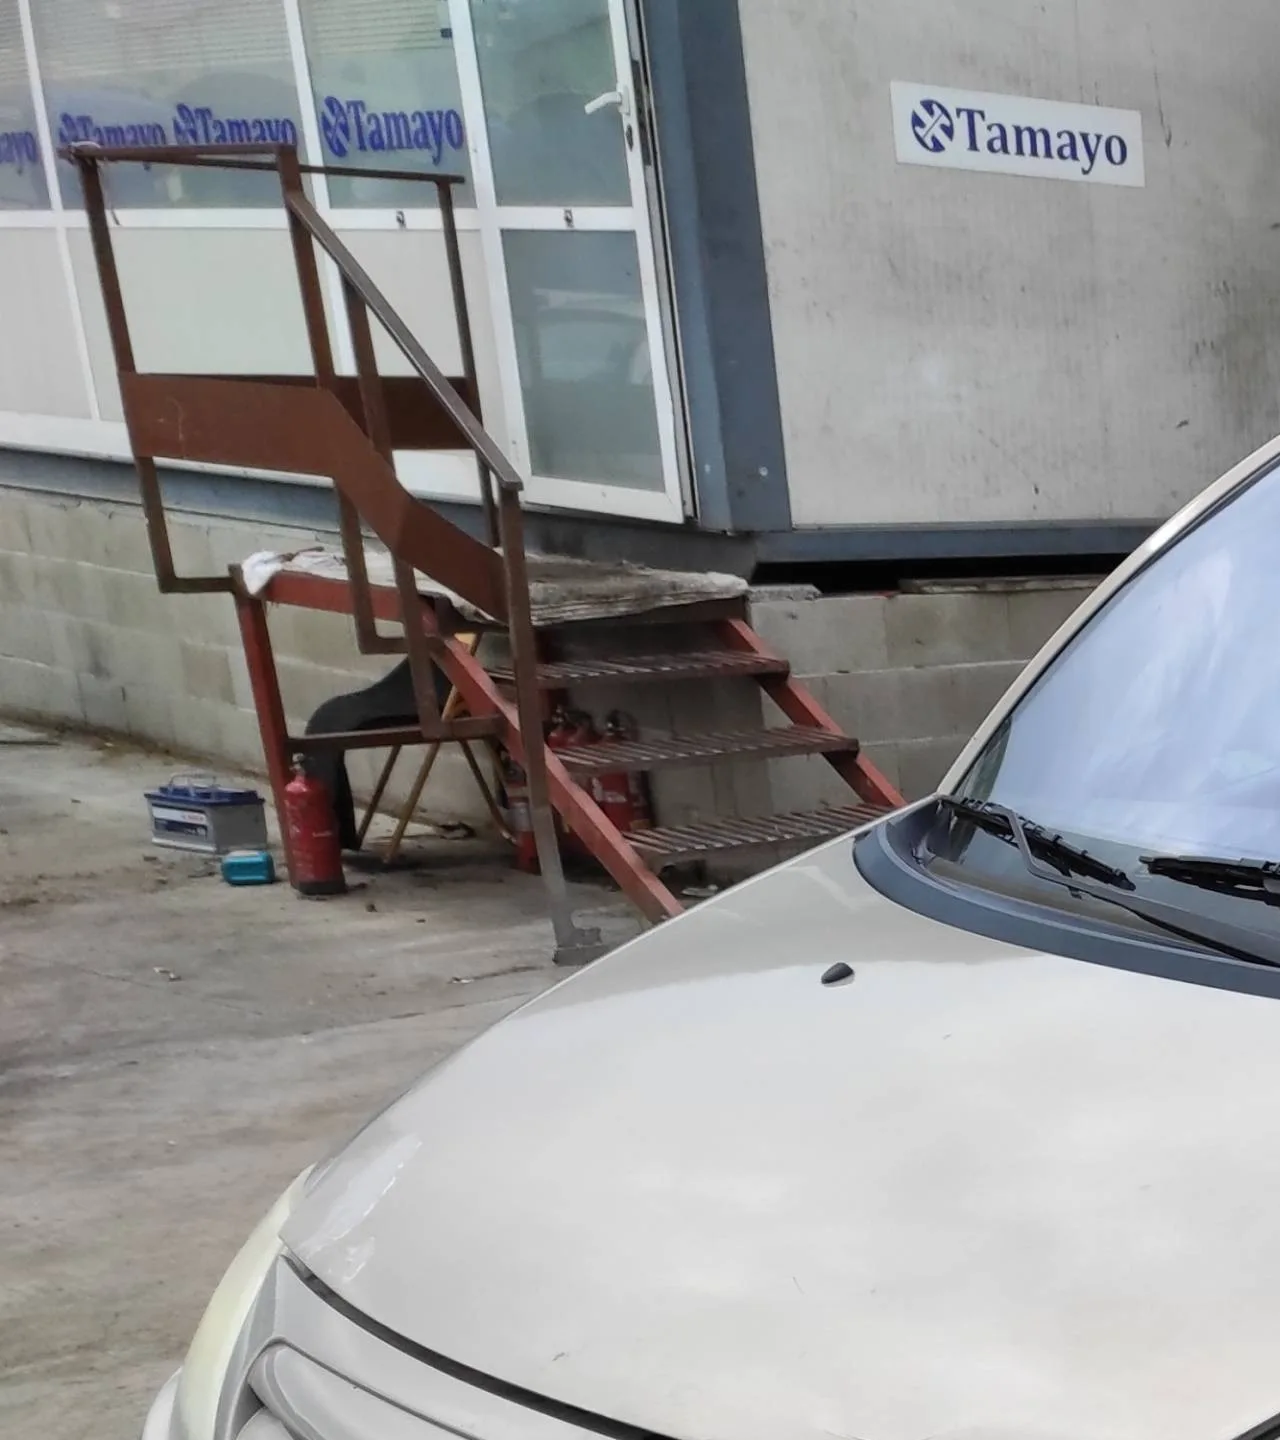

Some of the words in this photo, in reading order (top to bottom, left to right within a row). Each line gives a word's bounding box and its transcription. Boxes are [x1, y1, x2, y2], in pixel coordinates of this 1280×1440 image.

[0, 131, 37, 177] ayo
[347, 99, 464, 166] Tamayo
[955, 107, 1128, 176] Tamayo
